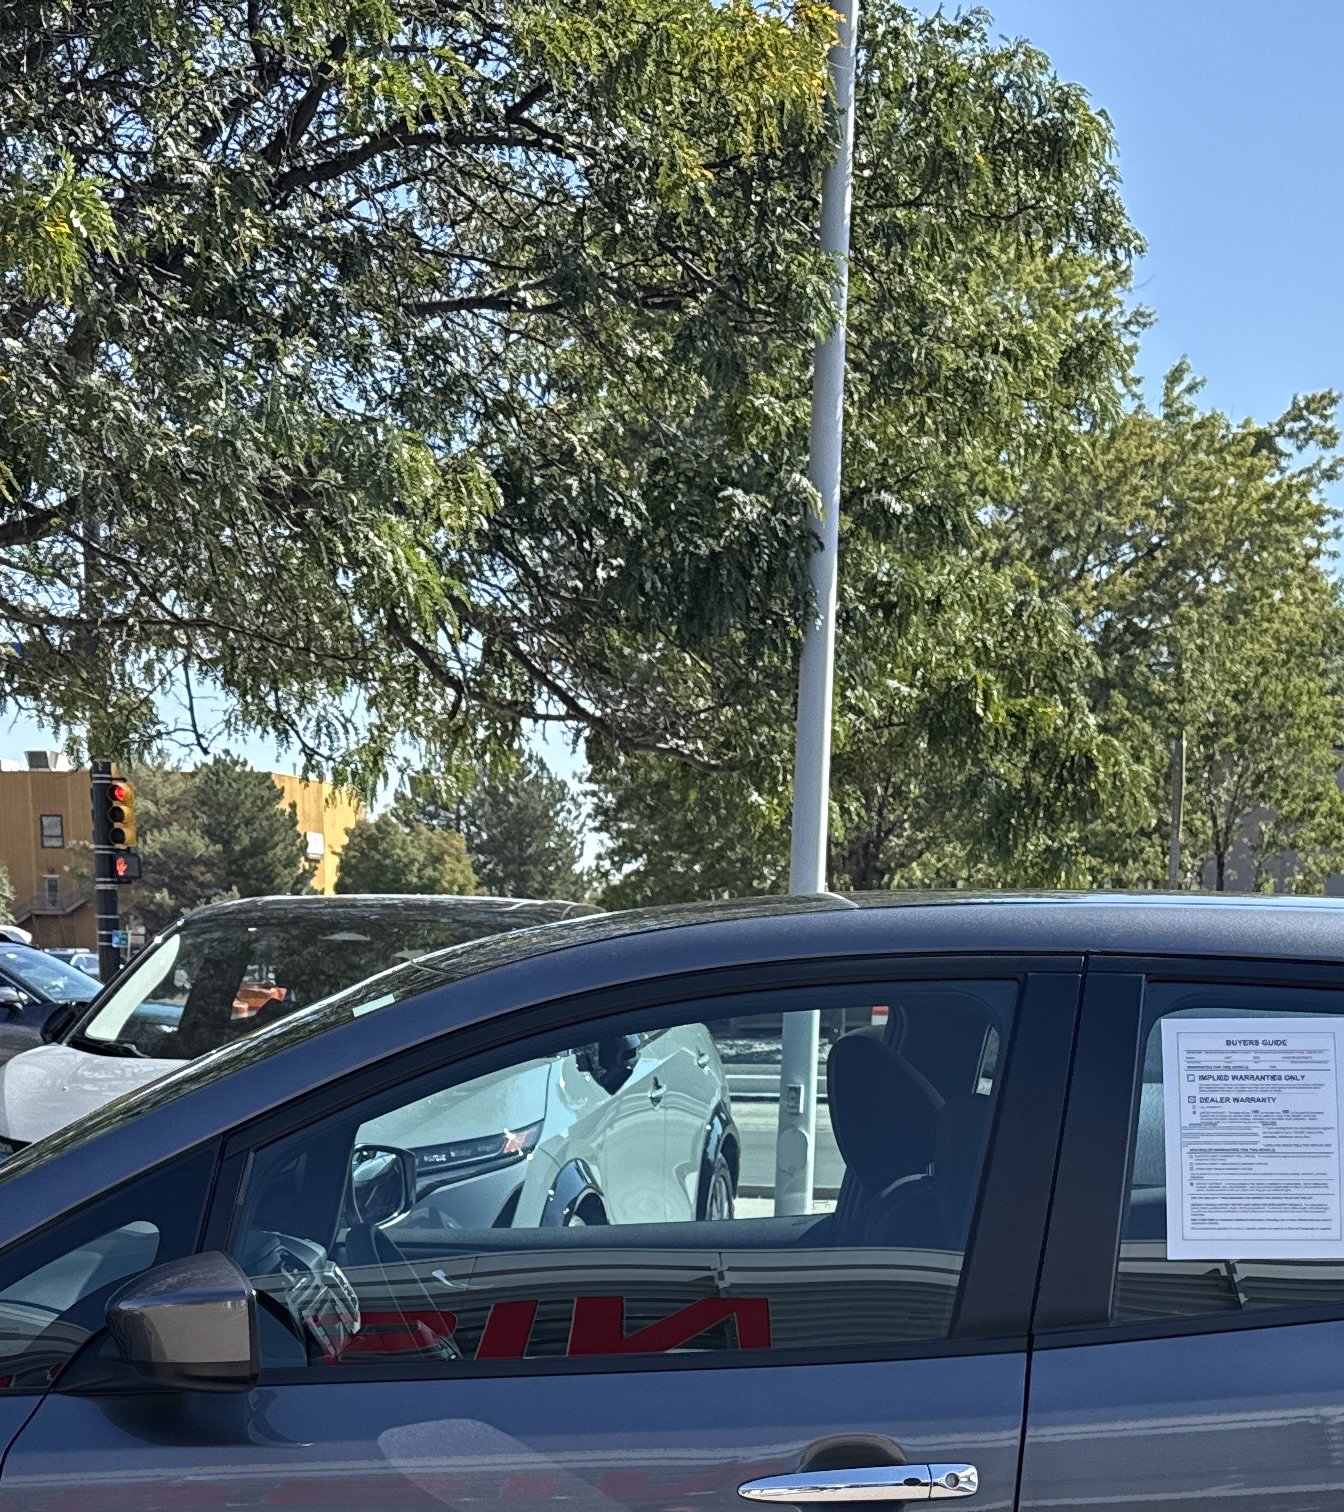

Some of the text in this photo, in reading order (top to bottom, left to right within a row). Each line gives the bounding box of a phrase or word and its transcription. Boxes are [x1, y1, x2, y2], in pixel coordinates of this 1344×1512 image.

[1225, 1039, 1288, 1047] BUYERS GUIDE
[1199, 1096, 1277, 1104] DEALER WARRANTY
